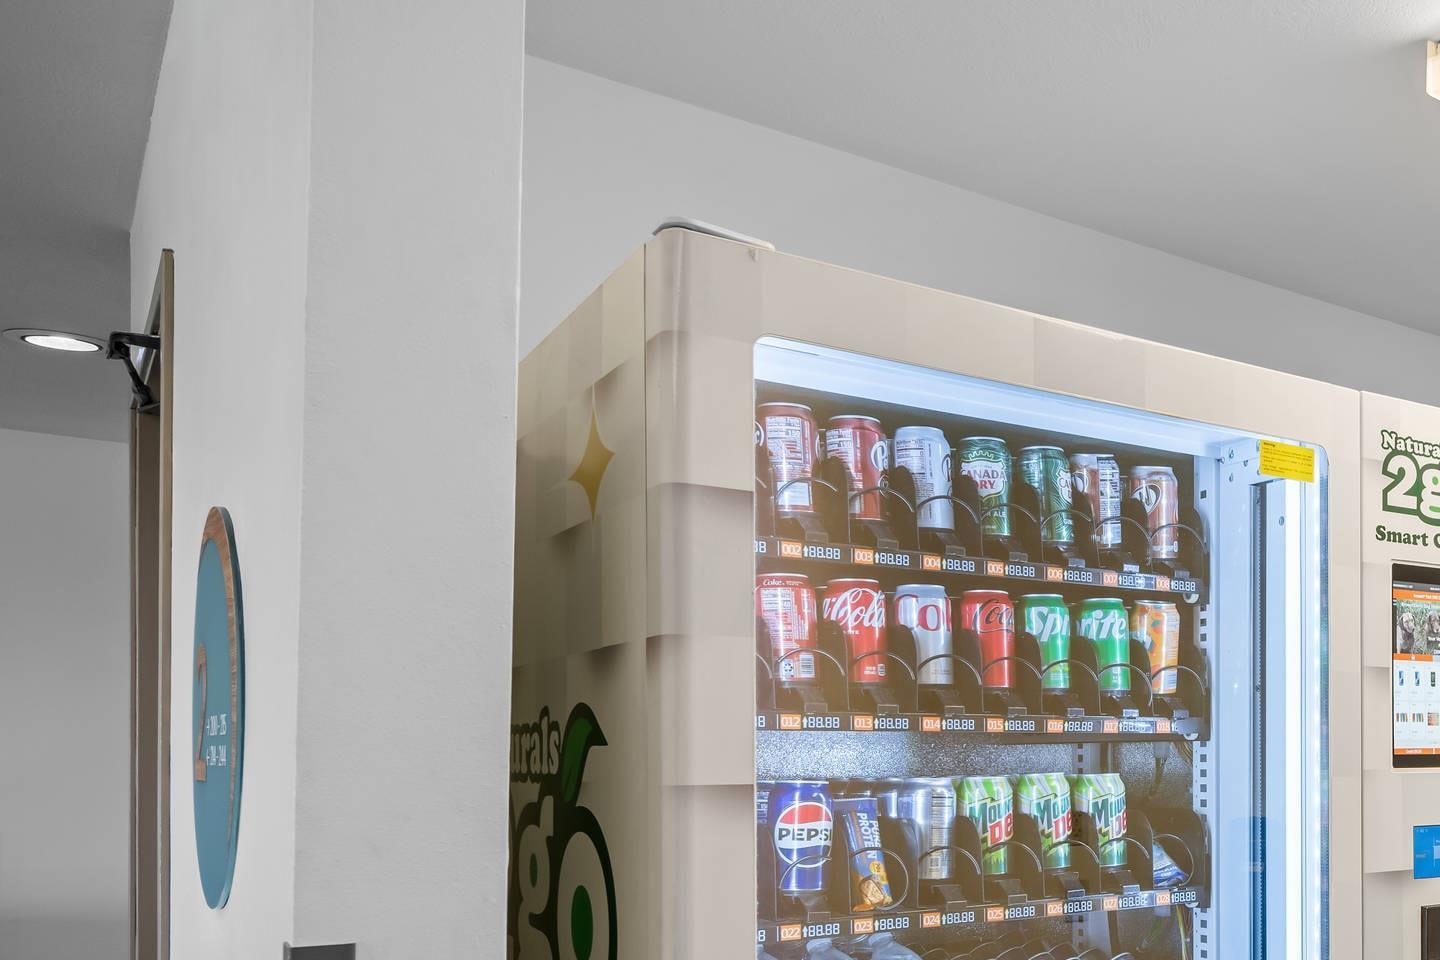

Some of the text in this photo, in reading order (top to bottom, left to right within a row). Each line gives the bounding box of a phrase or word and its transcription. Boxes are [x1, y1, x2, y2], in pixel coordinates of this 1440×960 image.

[961, 468, 1006, 480] CANADA
[1375, 525, 1429, 547] Smart
[783, 544, 841, 559] 002 88.88
[855, 551, 910, 566] 003 88.88
[923, 557, 975, 572] 004 88.88
[988, 562, 1036, 577] 005 88.88
[1048, 569, 1093, 582] 006 88.88
[1104, 574, 1117, 584] 007
[1173, 579, 1196, 592] 88.88
[782, 716, 840, 728] 012 88.88
[855, 717, 909, 729] 013 88.88
[923, 719, 975, 731] 014 88.88
[987, 720, 1035, 731] 015 88.88
[1048, 721, 1093, 732] 016 88.88
[510, 705, 561, 783] urals
[778, 827, 832, 841] PEPSI
[856, 813, 878, 859] PROTEN
[1174, 891, 1196, 903] 88.88
[988, 906, 1035, 918] 025 88.88
[1048, 901, 1093, 913] 026 88.88
[855, 917, 910, 931] 023 88.88
[923, 911, 975, 925] 024 88.88
[781, 923, 840, 938] 022 88.88
